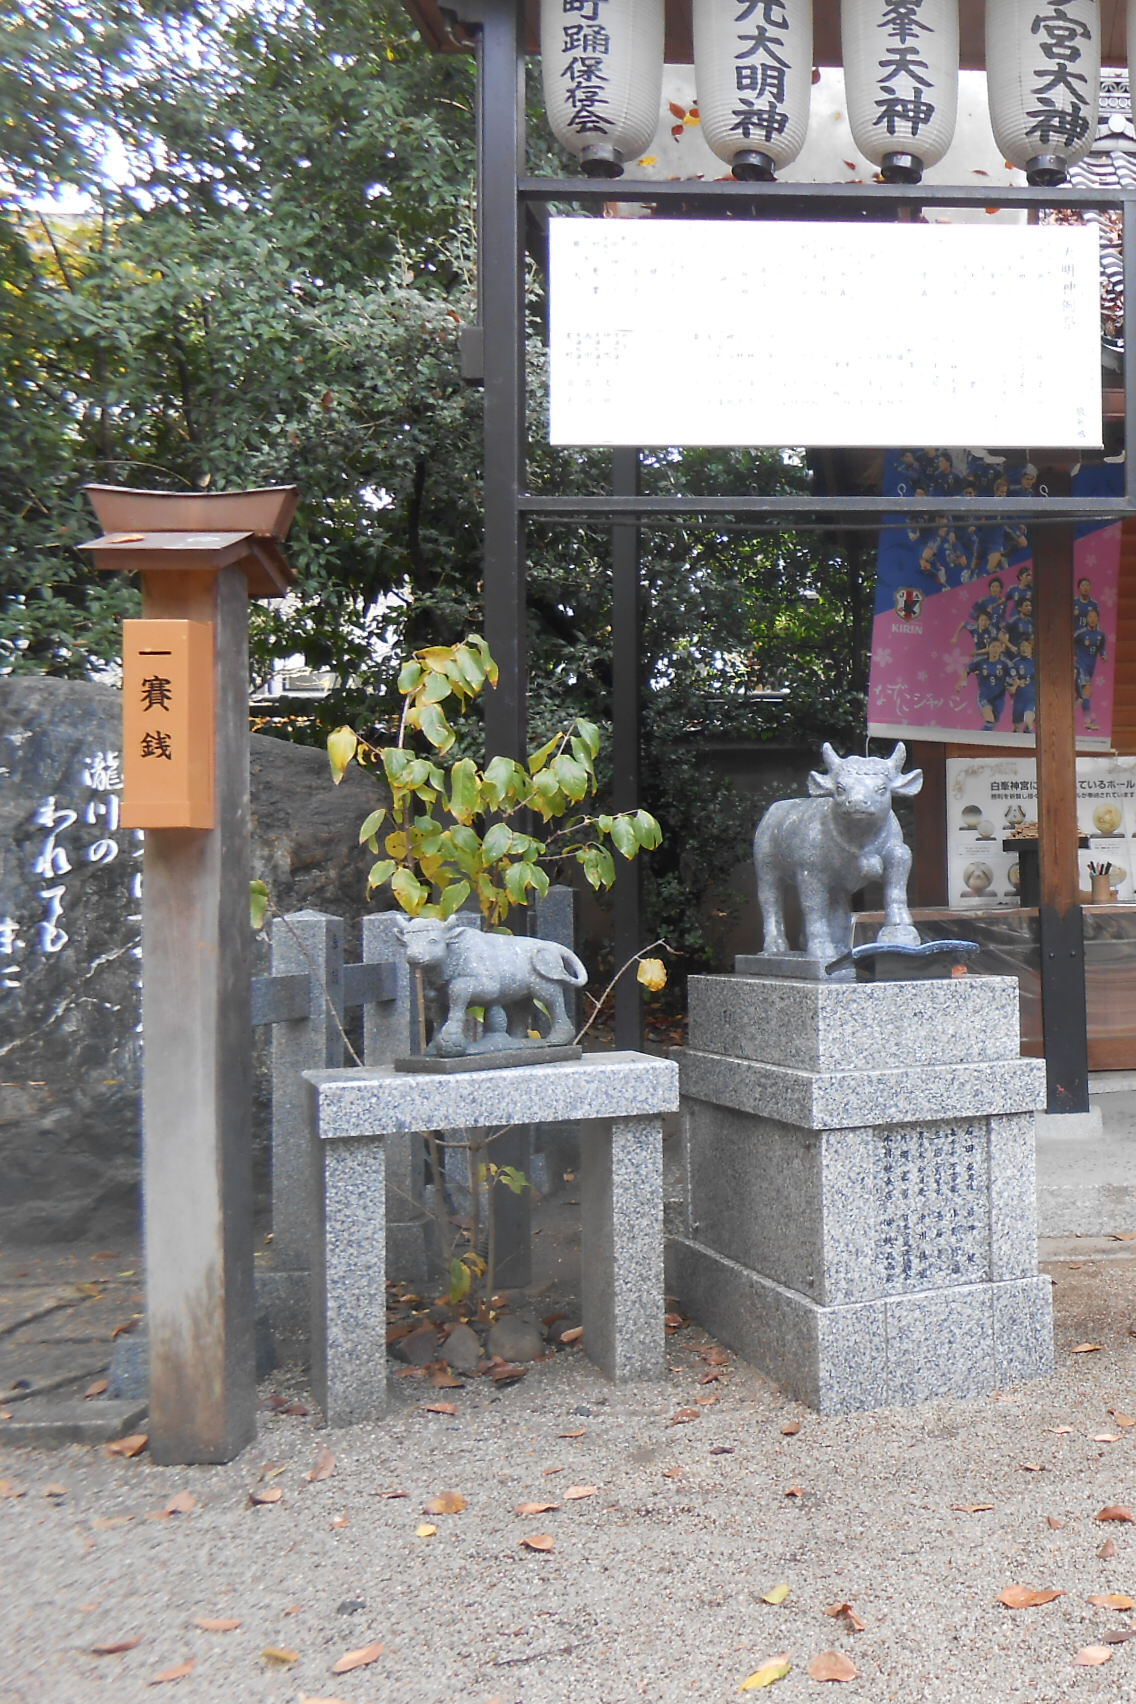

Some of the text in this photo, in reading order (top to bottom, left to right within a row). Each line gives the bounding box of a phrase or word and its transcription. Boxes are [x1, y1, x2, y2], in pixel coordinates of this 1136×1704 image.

[1025, 0, 1094, 147] 宮大神
[892, 623, 923, 635] KIRIN
[140, 675, 172, 761] 賽銭
